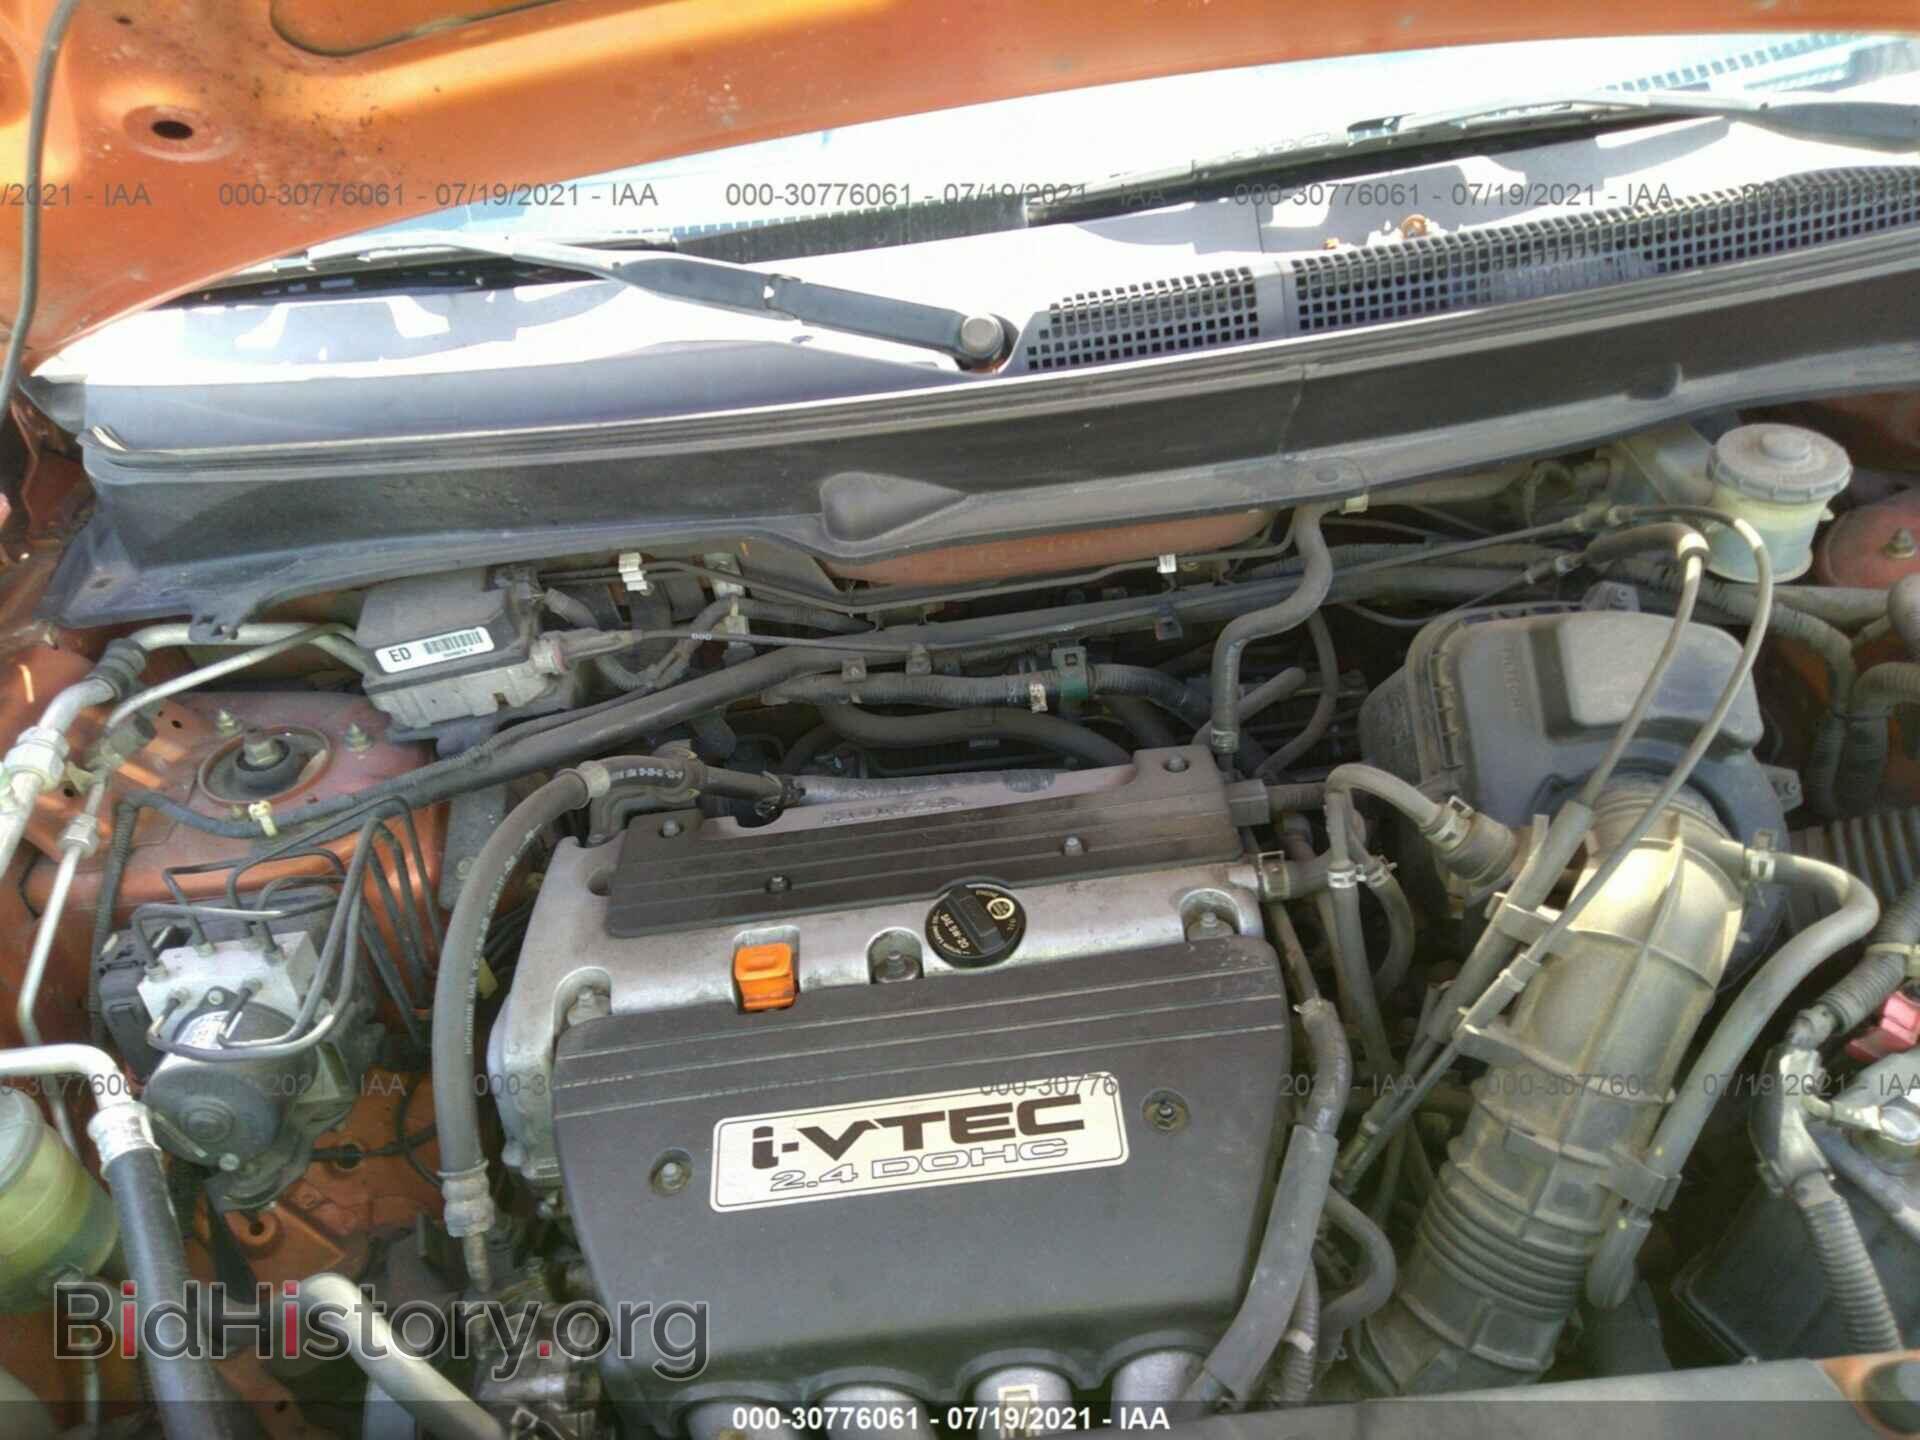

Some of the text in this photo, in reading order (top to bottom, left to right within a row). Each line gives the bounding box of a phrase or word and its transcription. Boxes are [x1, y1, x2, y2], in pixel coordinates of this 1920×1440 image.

[388, 646, 412, 663] ED
[752, 1094, 1085, 1170] i-VTEC
[769, 1137, 1068, 1192] 2.4 DOHC
